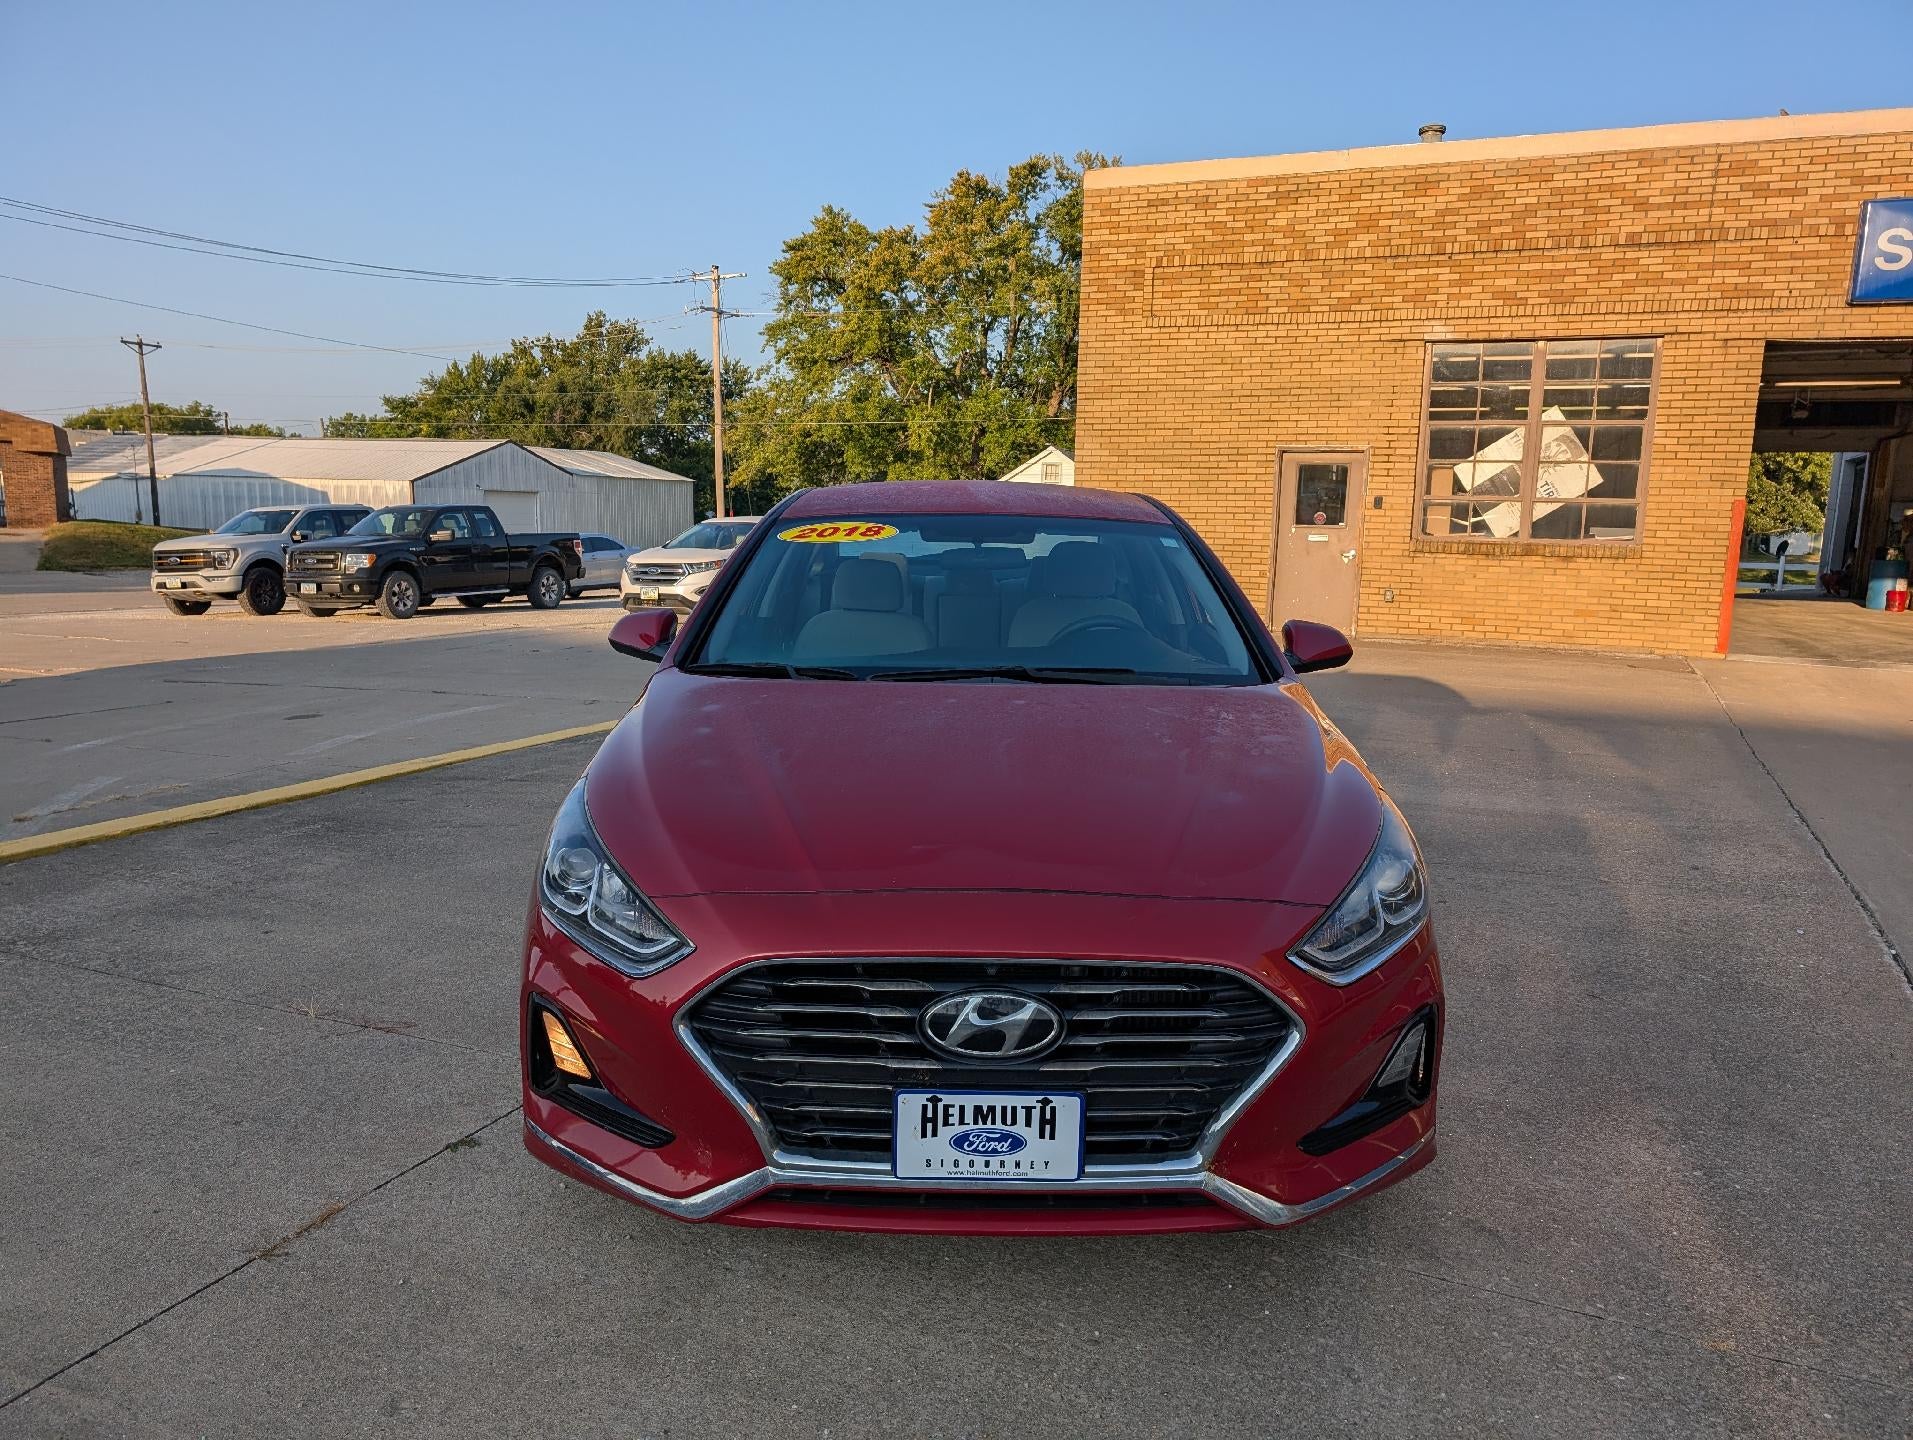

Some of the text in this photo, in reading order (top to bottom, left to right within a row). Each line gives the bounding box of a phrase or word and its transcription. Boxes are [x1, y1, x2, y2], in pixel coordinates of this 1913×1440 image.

[1875, 227, 1913, 271] S
[790, 525, 886, 539] 2018
[920, 1095, 1057, 1140] HELMUTH
[963, 1131, 1012, 1152] Ford
